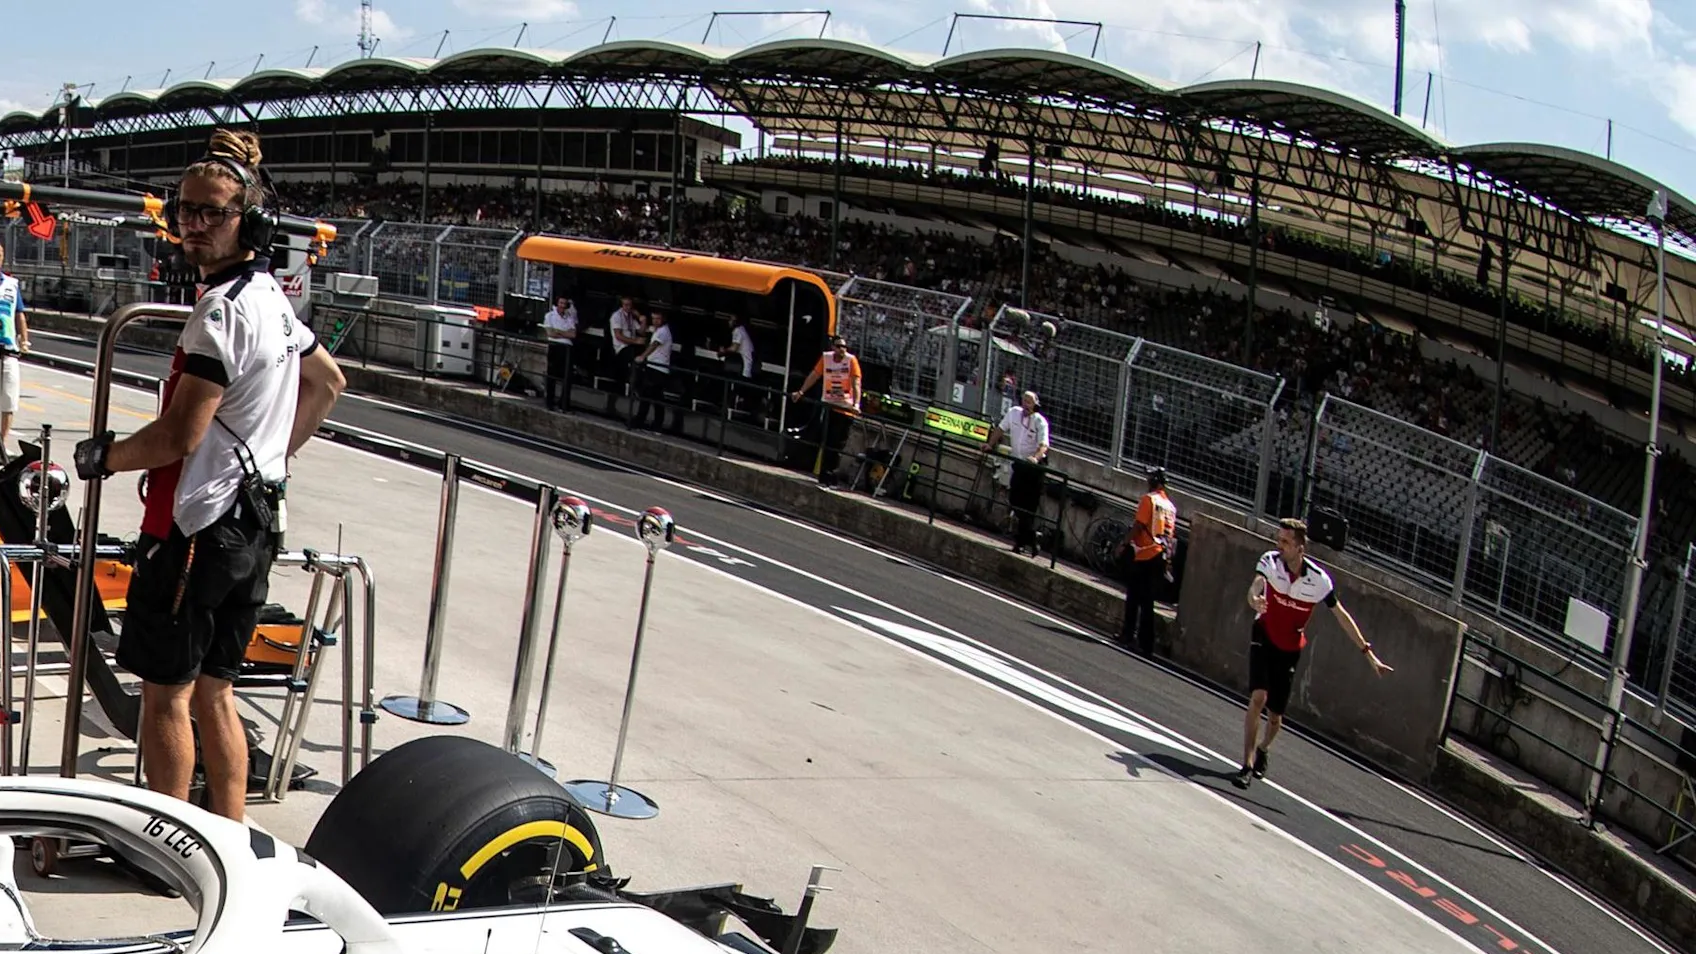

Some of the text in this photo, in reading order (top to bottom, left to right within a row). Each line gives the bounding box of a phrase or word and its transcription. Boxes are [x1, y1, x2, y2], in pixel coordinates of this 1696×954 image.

[594, 248, 676, 263] McLaren
[142, 815, 203, 859] 16 LEC
